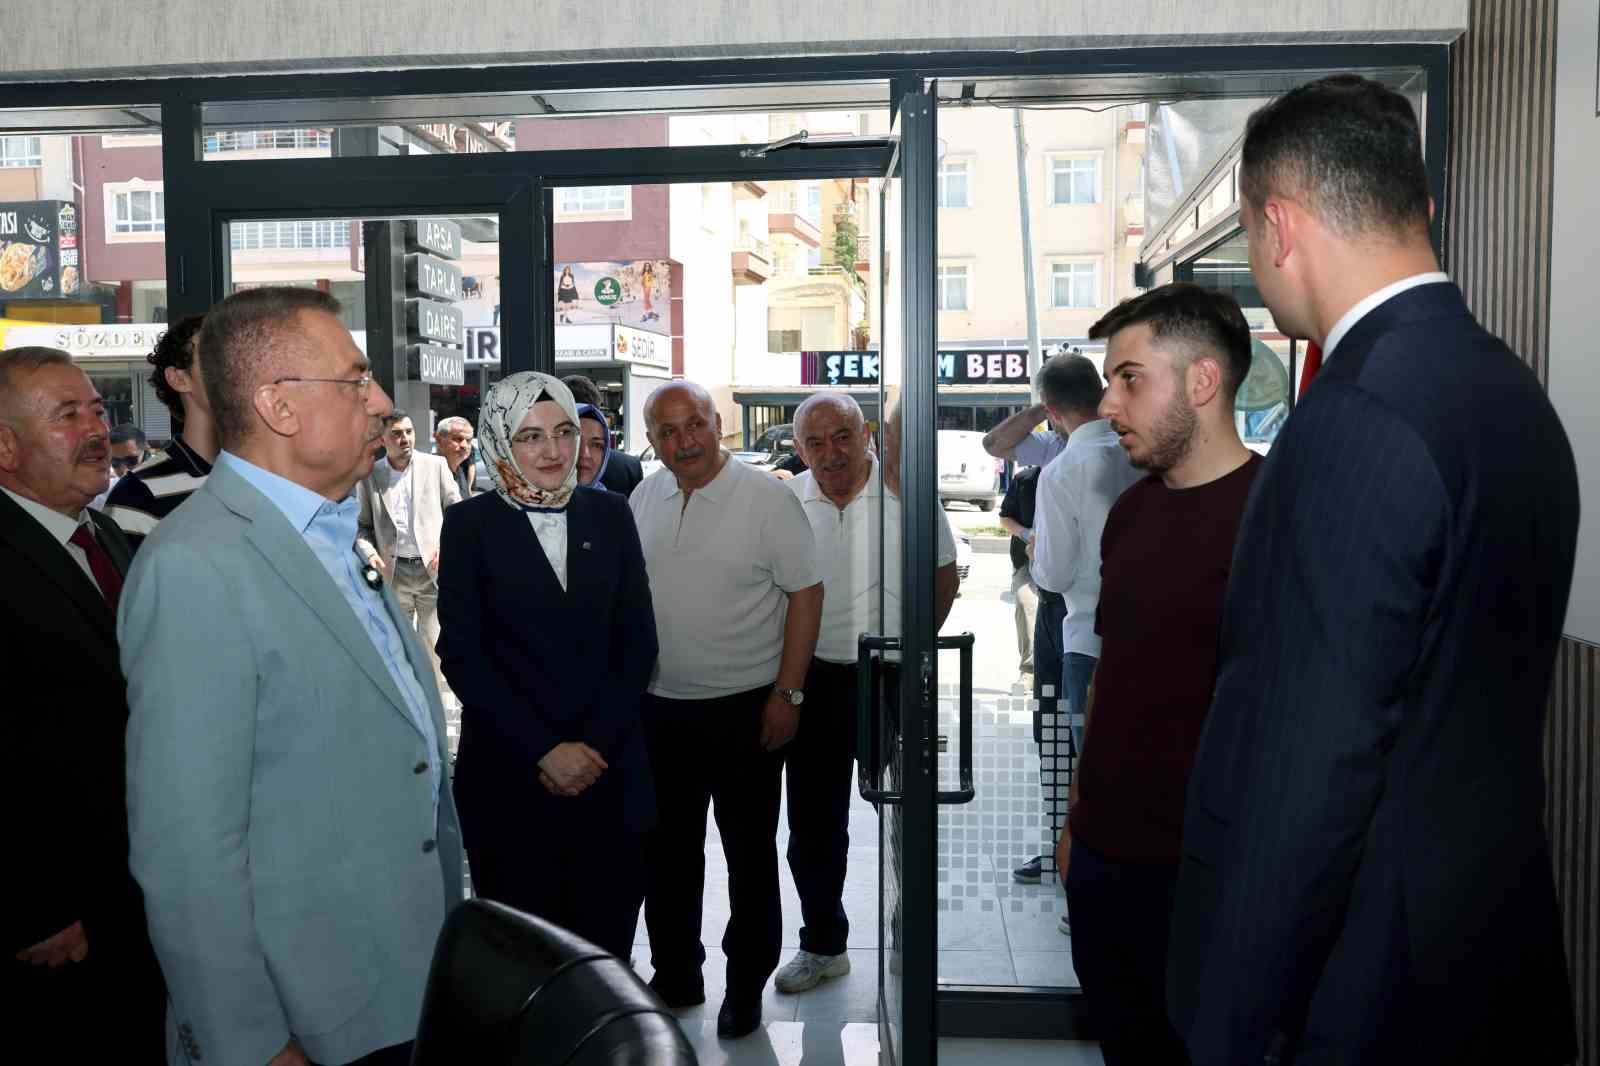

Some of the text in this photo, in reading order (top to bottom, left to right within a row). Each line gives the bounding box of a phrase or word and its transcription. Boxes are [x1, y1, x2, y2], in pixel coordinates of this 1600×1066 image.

[426, 222, 453, 251] ARSA
[423, 263, 458, 297] TARLA
[426, 307, 457, 340] DAİRE
[466, 330, 498, 360] İR
[422, 349, 464, 380] DÜKKAN
[967, 353, 1030, 378] BEB
